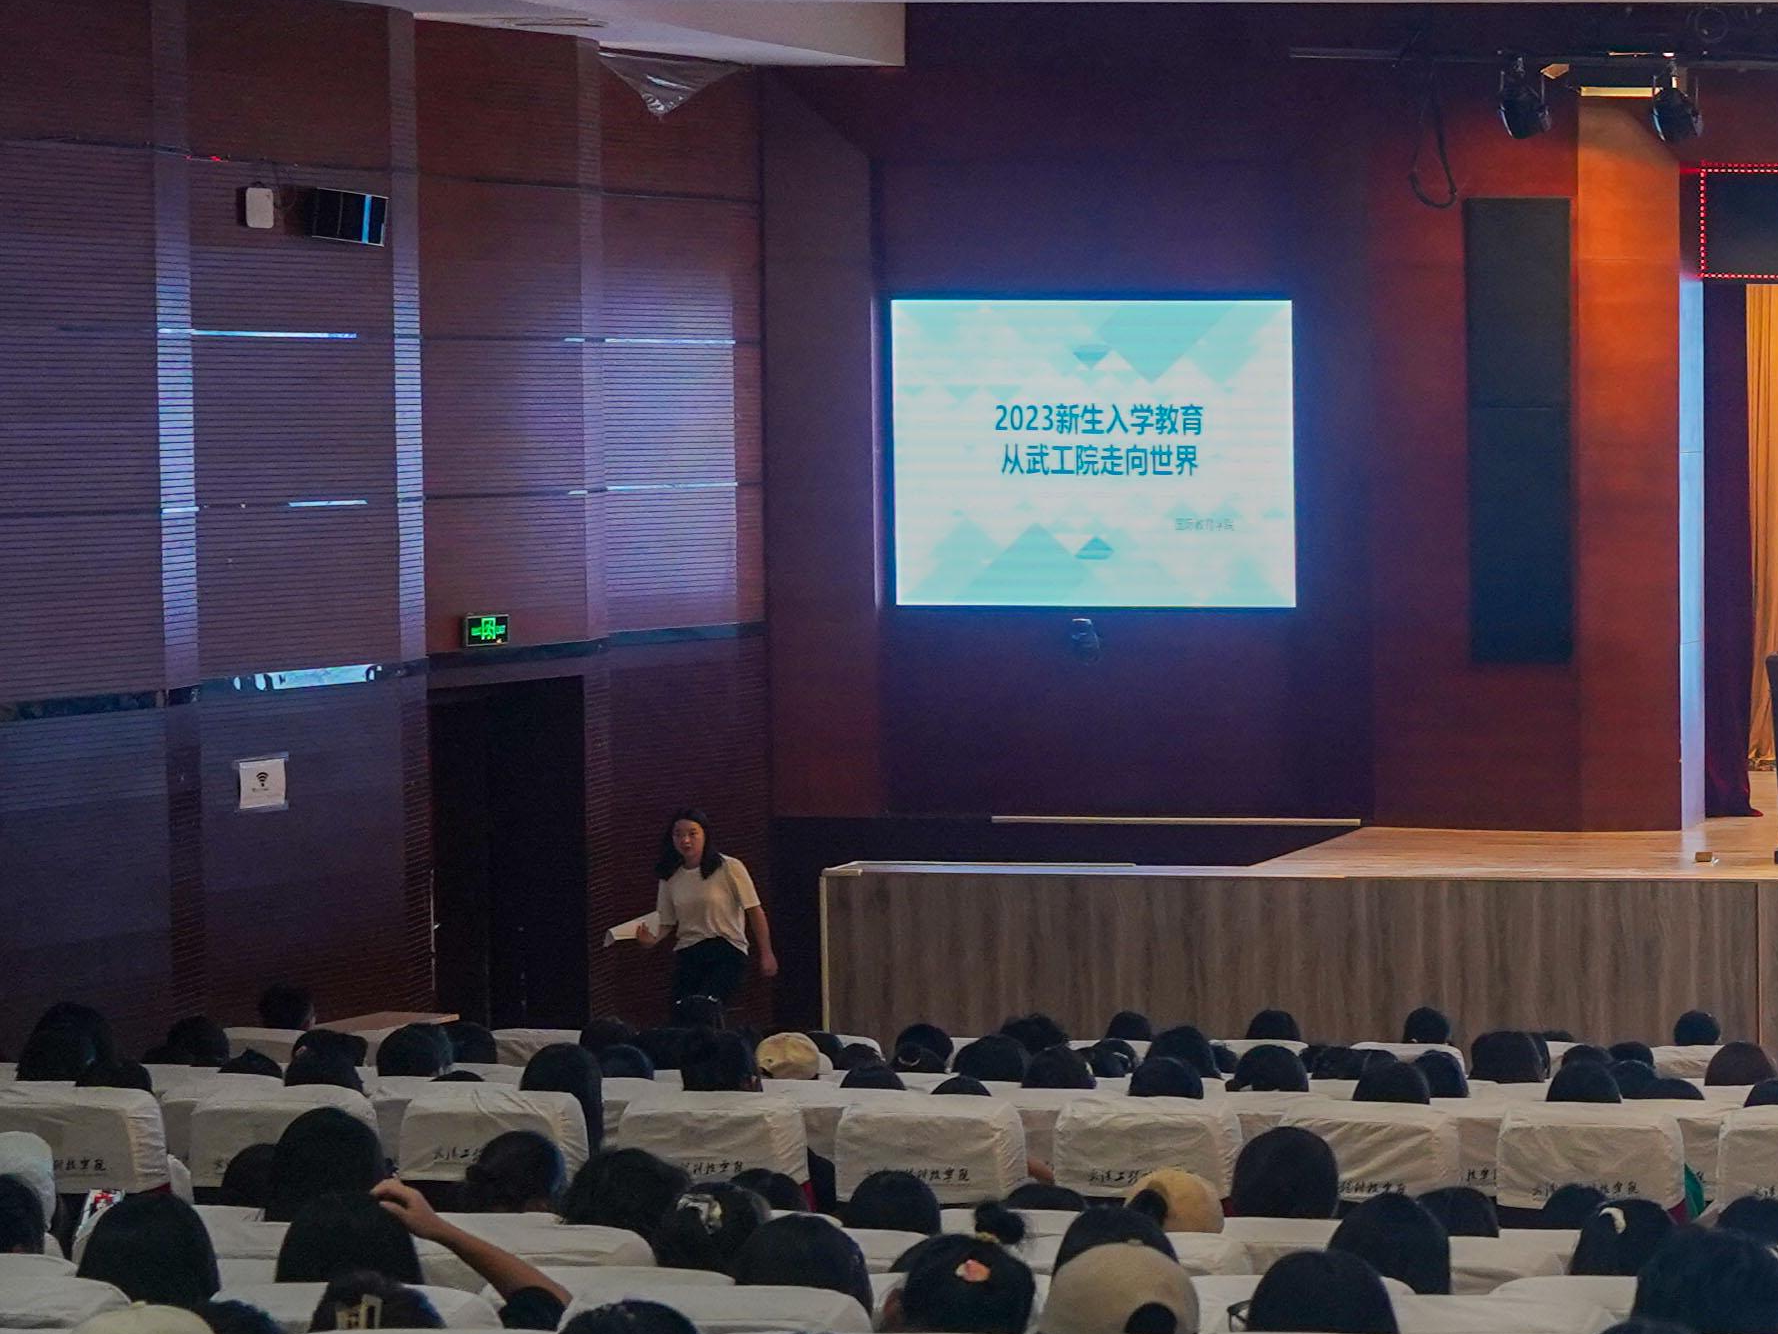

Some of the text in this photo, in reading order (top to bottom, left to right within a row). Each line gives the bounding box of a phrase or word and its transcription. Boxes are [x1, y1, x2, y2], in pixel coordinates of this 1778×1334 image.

[994, 403, 1204, 436] 2023新生入学教育
[1001, 444, 1199, 476] 从武工院走向世界
